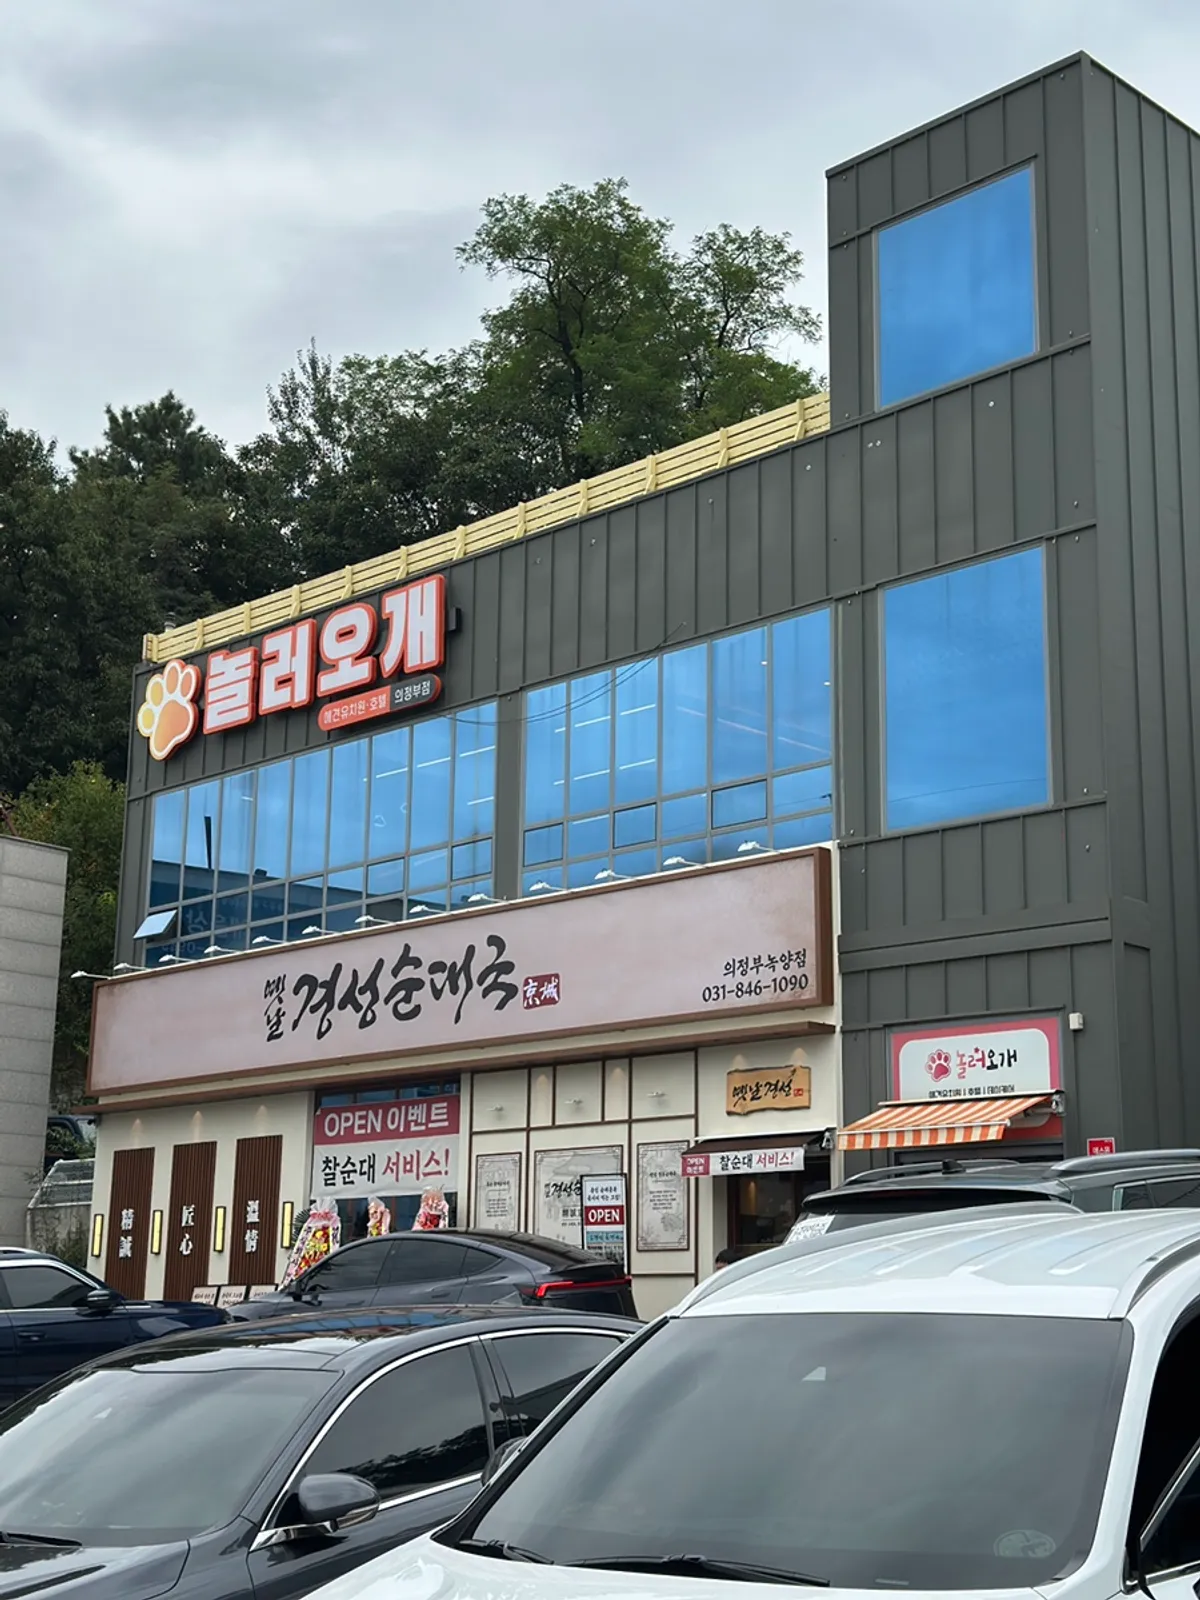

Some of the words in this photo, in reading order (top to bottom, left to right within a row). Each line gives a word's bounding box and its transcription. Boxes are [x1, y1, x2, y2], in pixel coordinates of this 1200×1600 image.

[204, 574, 445, 733] 놀러오개
[395, 681, 431, 704] 의정부점
[723, 948, 807, 978] 의정부녹양점
[702, 974, 809, 1002] 031-846-1090
[324, 1109, 382, 1137] OPEN
[386, 1102, 449, 1132] 이벤트
[322, 1152, 376, 1186] 찰순대
[382, 1148, 450, 1182] 서비스!
[720, 1154, 754, 1171] 찰순대
[756, 1152, 795, 1168] 서비스!
[588, 1208, 620, 1223] OPEN
